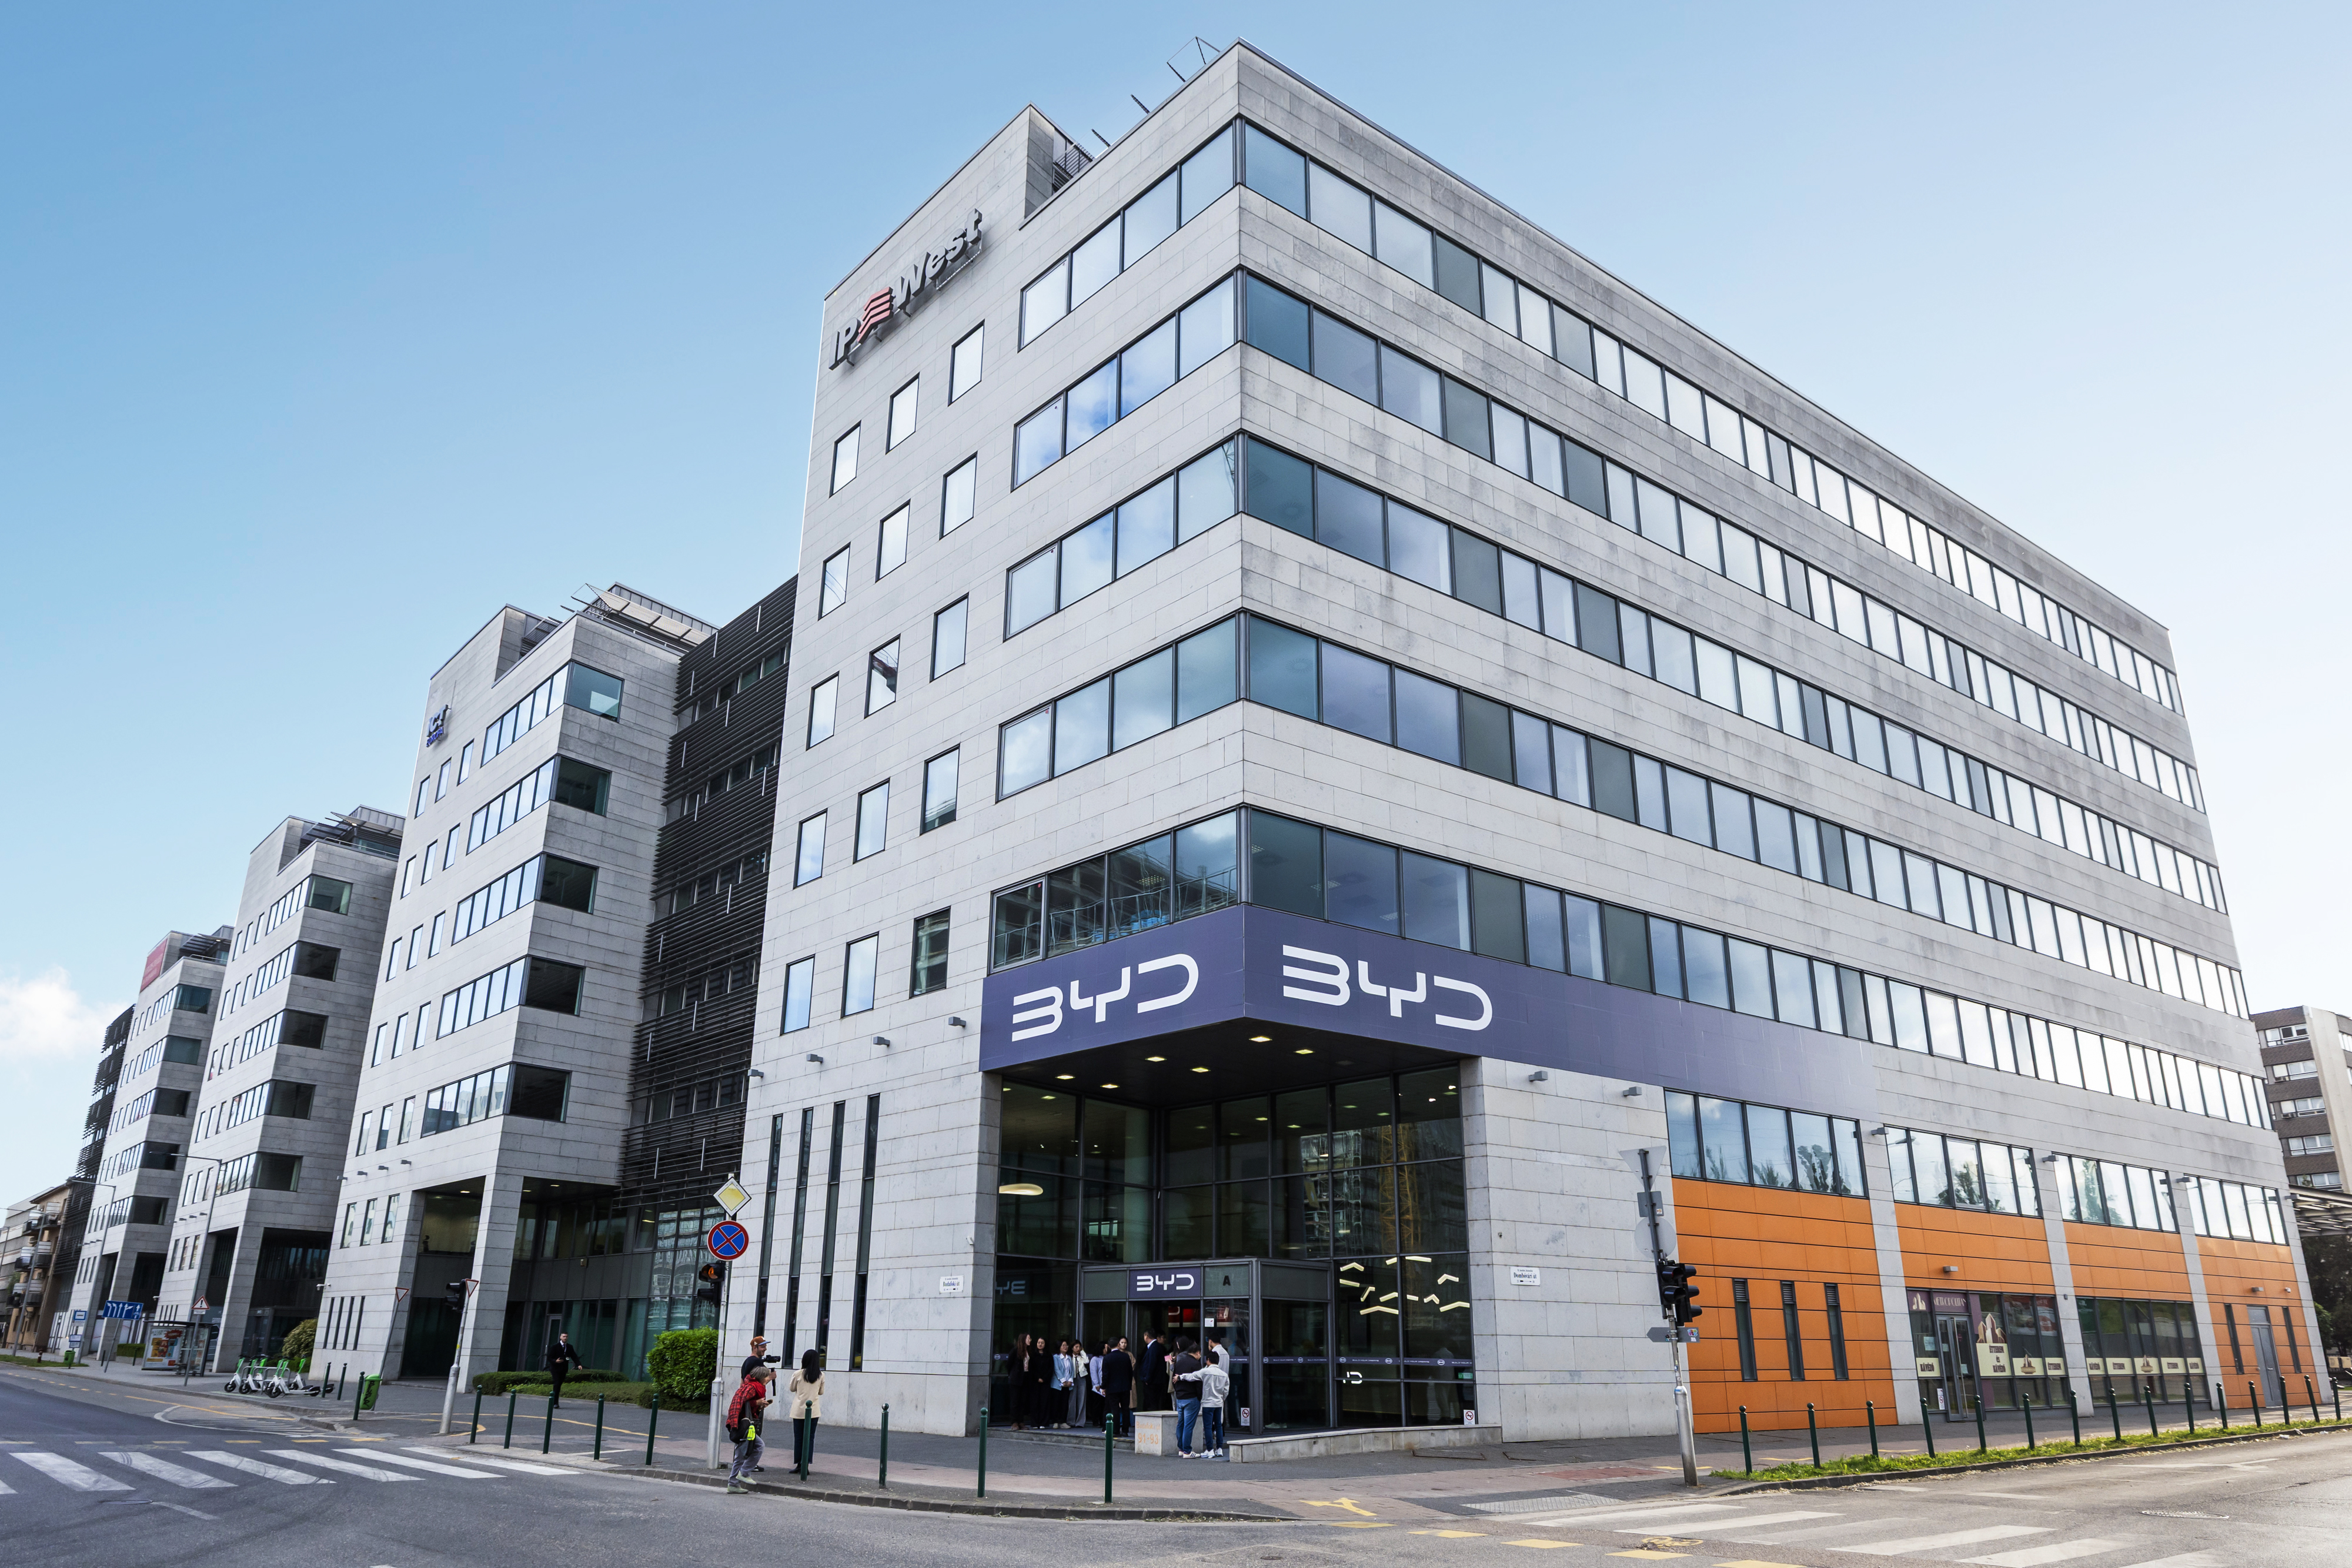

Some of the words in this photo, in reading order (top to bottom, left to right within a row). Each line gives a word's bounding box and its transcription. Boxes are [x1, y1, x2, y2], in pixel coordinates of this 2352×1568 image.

[828, 317, 861, 370] IP
[893, 208, 983, 310] West
[1283, 945, 1493, 1031] BYD
[1012, 954, 1198, 1042] BYD
[1137, 1274, 1194, 1291] BYD
[1222, 1275, 1231, 1286] A
[1920, 1362, 1935, 1372] KÁVÉZÓ
[1138, 1433, 1158, 1445] 91-93
